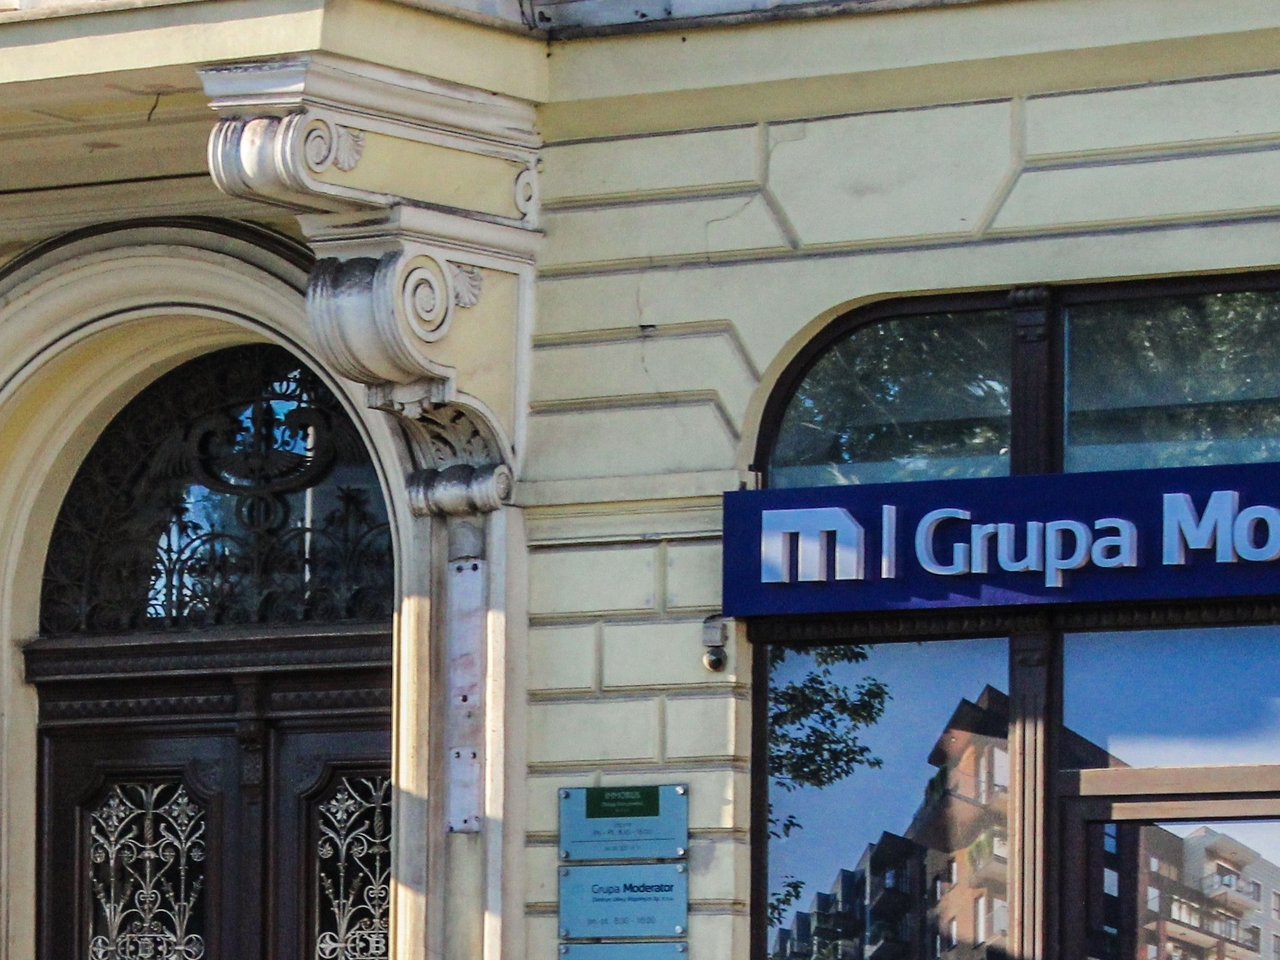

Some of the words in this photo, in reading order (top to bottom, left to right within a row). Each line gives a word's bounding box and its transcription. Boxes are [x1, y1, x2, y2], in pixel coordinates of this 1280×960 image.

[915, 508, 1137, 587] Grupa
[1162, 490, 1280, 565] Mo
[591, 884, 620, 894] Grupa
[623, 883, 674, 893] Moderator
